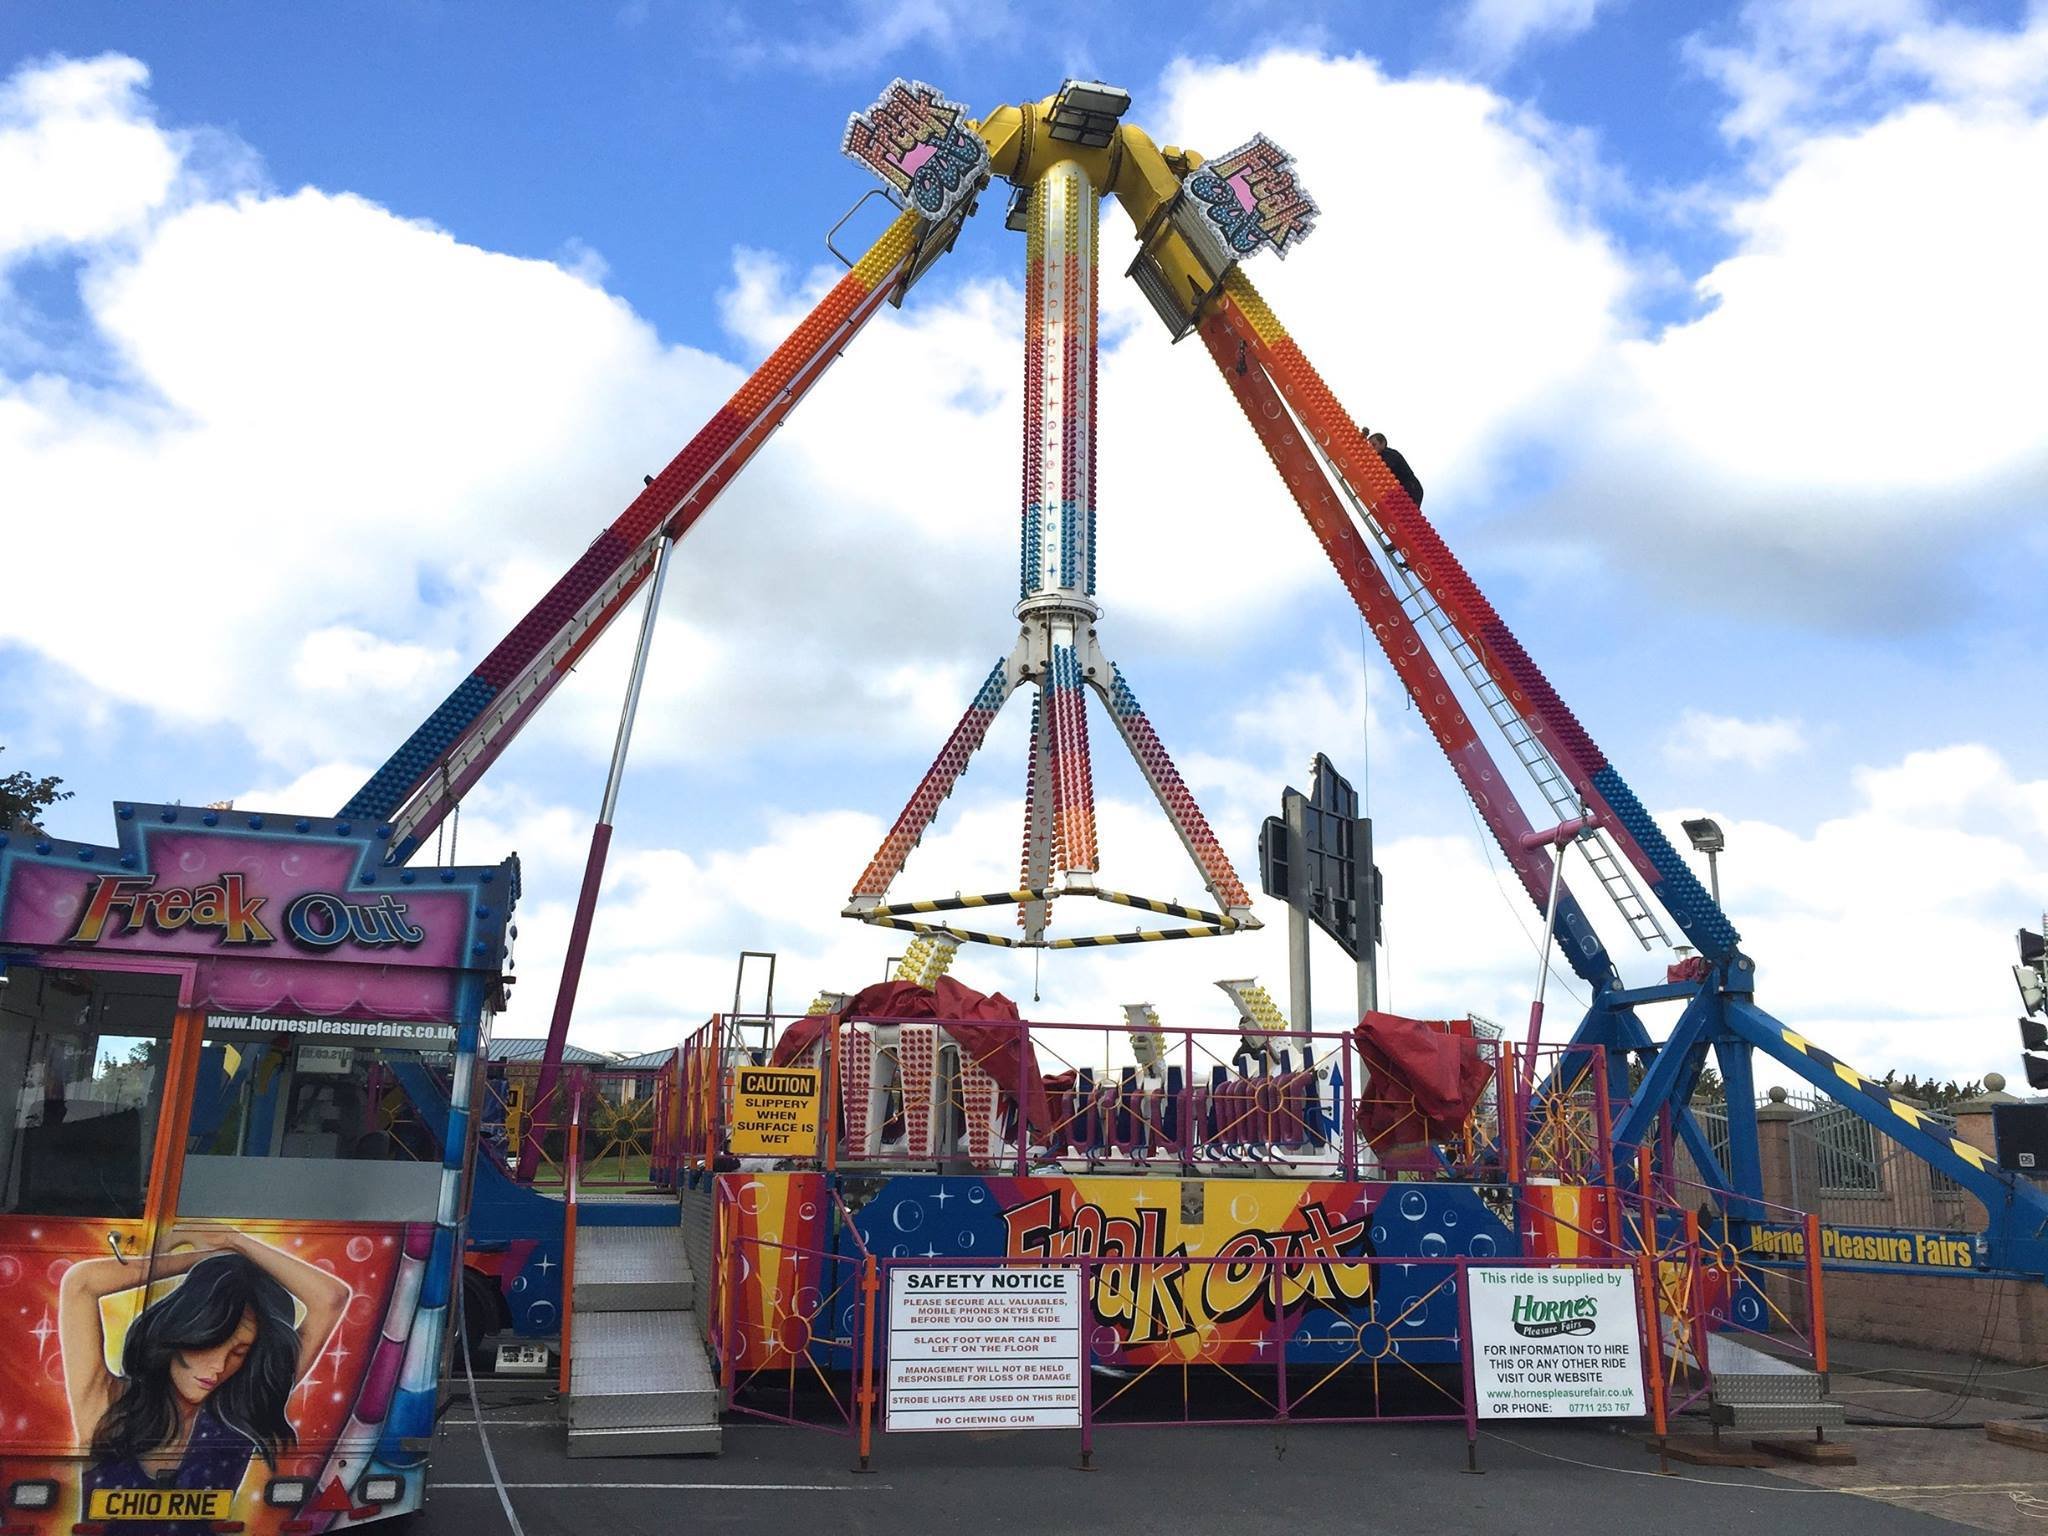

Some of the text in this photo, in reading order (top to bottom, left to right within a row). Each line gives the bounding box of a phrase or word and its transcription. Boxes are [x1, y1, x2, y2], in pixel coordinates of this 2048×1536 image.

[68, 873, 424, 945] Freak Out
[207, 1015, 457, 1040] www.hornespleasurefairs.co.uk
[746, 1075, 810, 1093] CAUTION
[745, 1098, 808, 1109] SLIPPERY
[756, 1110, 796, 1120] WHEN
[737, 1122, 814, 1132] SURFACE IS
[760, 1134, 790, 1143] WET
[1751, 1225, 1972, 1267] Horne Pleasure Fairs
[908, 1274, 1064, 1288] SAFETY NOTICE
[1480, 1272, 1622, 1286] This ride is supplied by
[987, 1298, 1006, 1306] ALL
[1008, 1298, 1068, 1306] VALUABLES,
[1523, 1321, 1582, 1336] Pleasure Fairs
[1484, 1345, 1629, 1355] FOR INFORMATION TO HIRE
[1489, 1359, 1626, 1369] THIS OR ANY OTHER RIDE
[905, 1366, 973, 1374] MANAGEMENT
[897, 1375, 964, 1383] RESPONSIBLE
[1032, 1373, 1071, 1381] DAMAGE
[1497, 1372, 1602, 1383] VISIT OUR WEBSITE
[1486, 1388, 1634, 1400] www.hornespleasurefair.co.uk
[892, 1396, 929, 1404] STROBE
[968, 1395, 987, 1403] ARE
[1492, 1403, 1630, 1413] OR PHONE: 07711 253 767
[955, 1416, 1007, 1424] CHEWING
[1010, 1415, 1035, 1423] GUM
[168, 1493, 218, 1515] RNE
